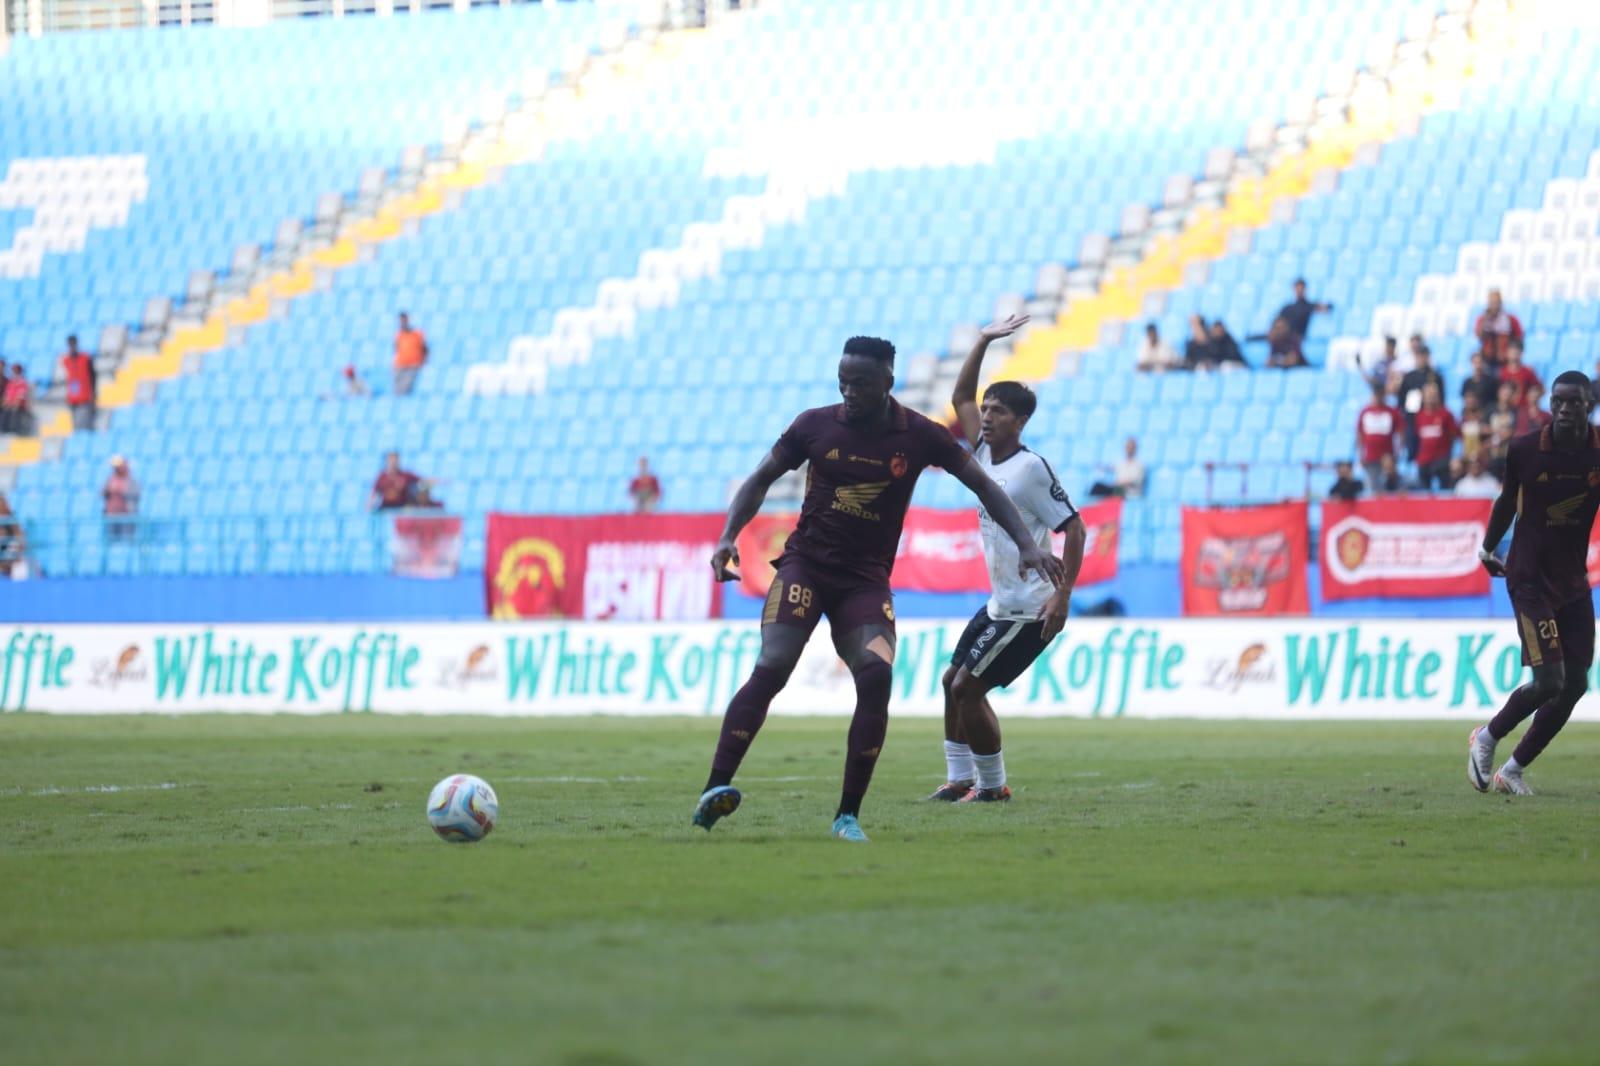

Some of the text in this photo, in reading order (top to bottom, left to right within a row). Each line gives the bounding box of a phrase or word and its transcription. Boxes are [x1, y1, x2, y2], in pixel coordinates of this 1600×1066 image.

[831, 501, 881, 522] HONDA
[788, 583, 812, 608] 88
[1538, 619, 1559, 640] 20
[0, 631, 75, 711] ffie
[155, 630, 278, 700] White
[286, 630, 421, 712] Koffie
[507, 629, 636, 699] White
[646, 628, 763, 714] Koff
[1028, 627, 1184, 713] Koffie
[1285, 626, 1442, 705] White
